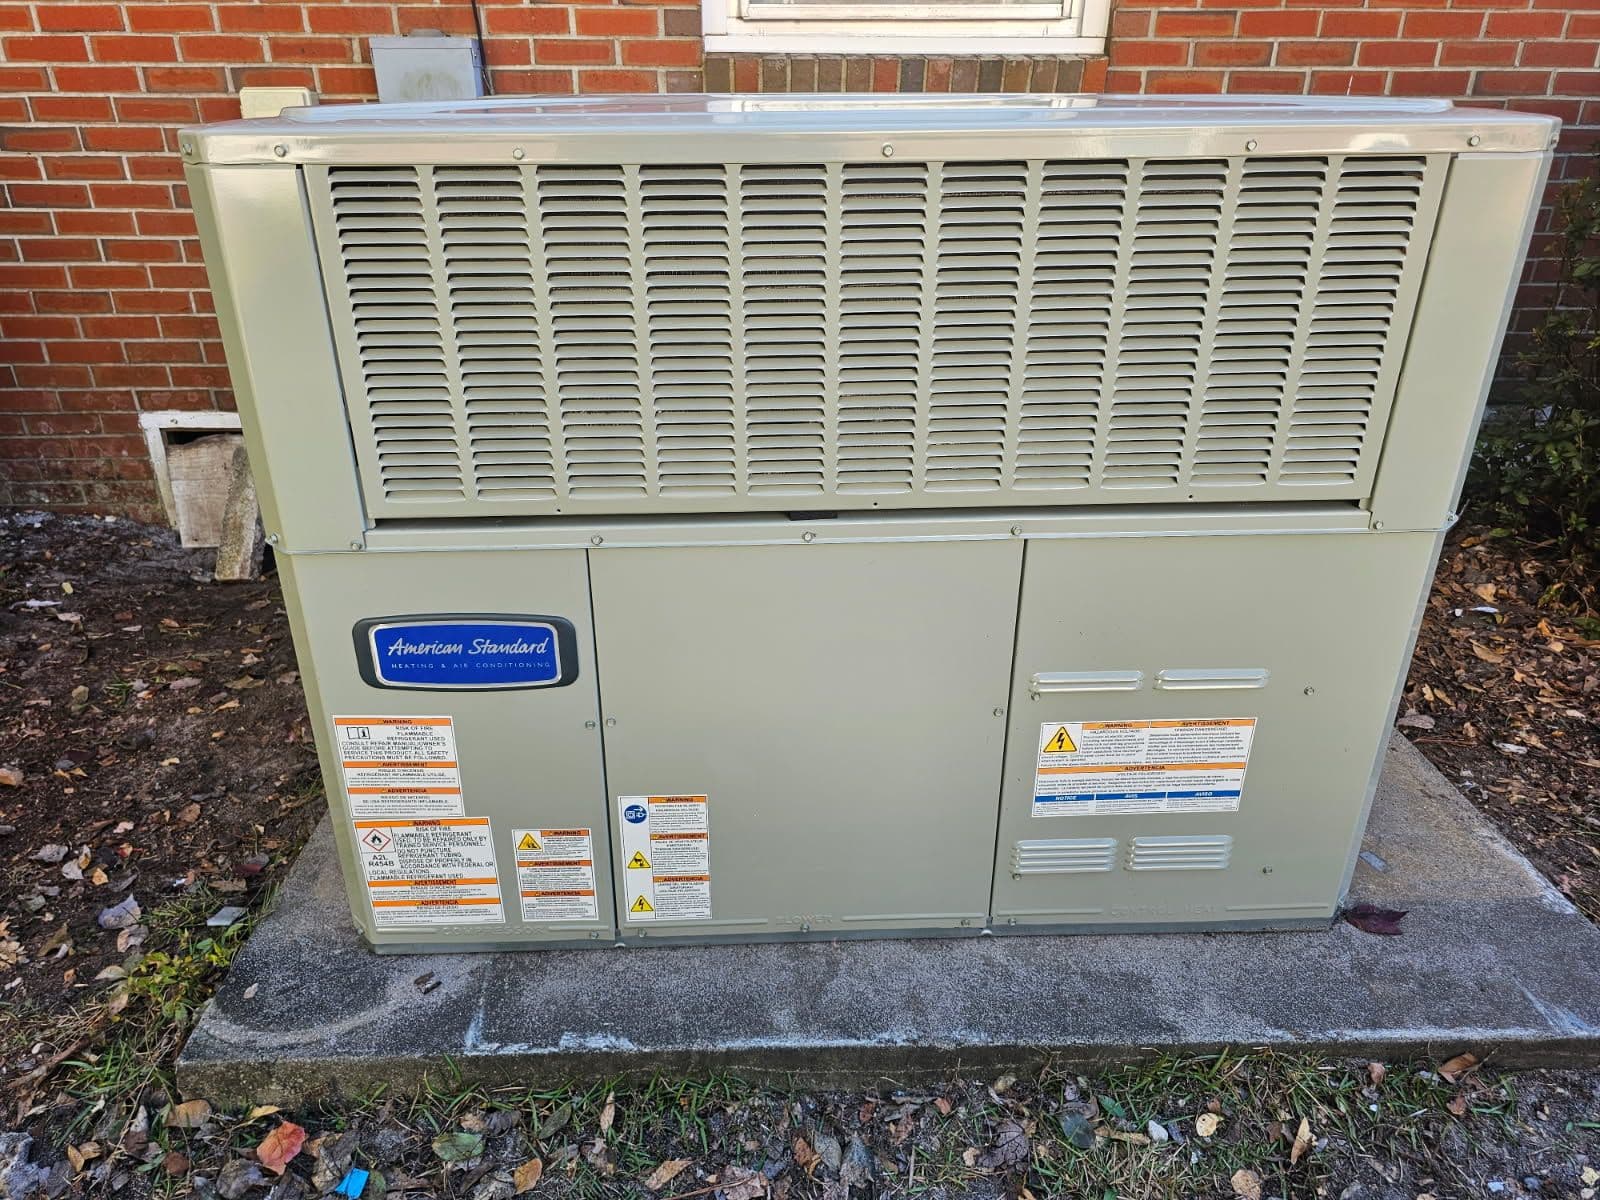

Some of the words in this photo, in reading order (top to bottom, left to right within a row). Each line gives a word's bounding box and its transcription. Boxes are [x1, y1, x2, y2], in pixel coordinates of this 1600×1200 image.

[388, 637, 462, 656] American
[468, 636, 550, 655] Standard
[776, 912, 832, 925] BLOWER
[441, 926, 546, 936] COMPRESSOR
